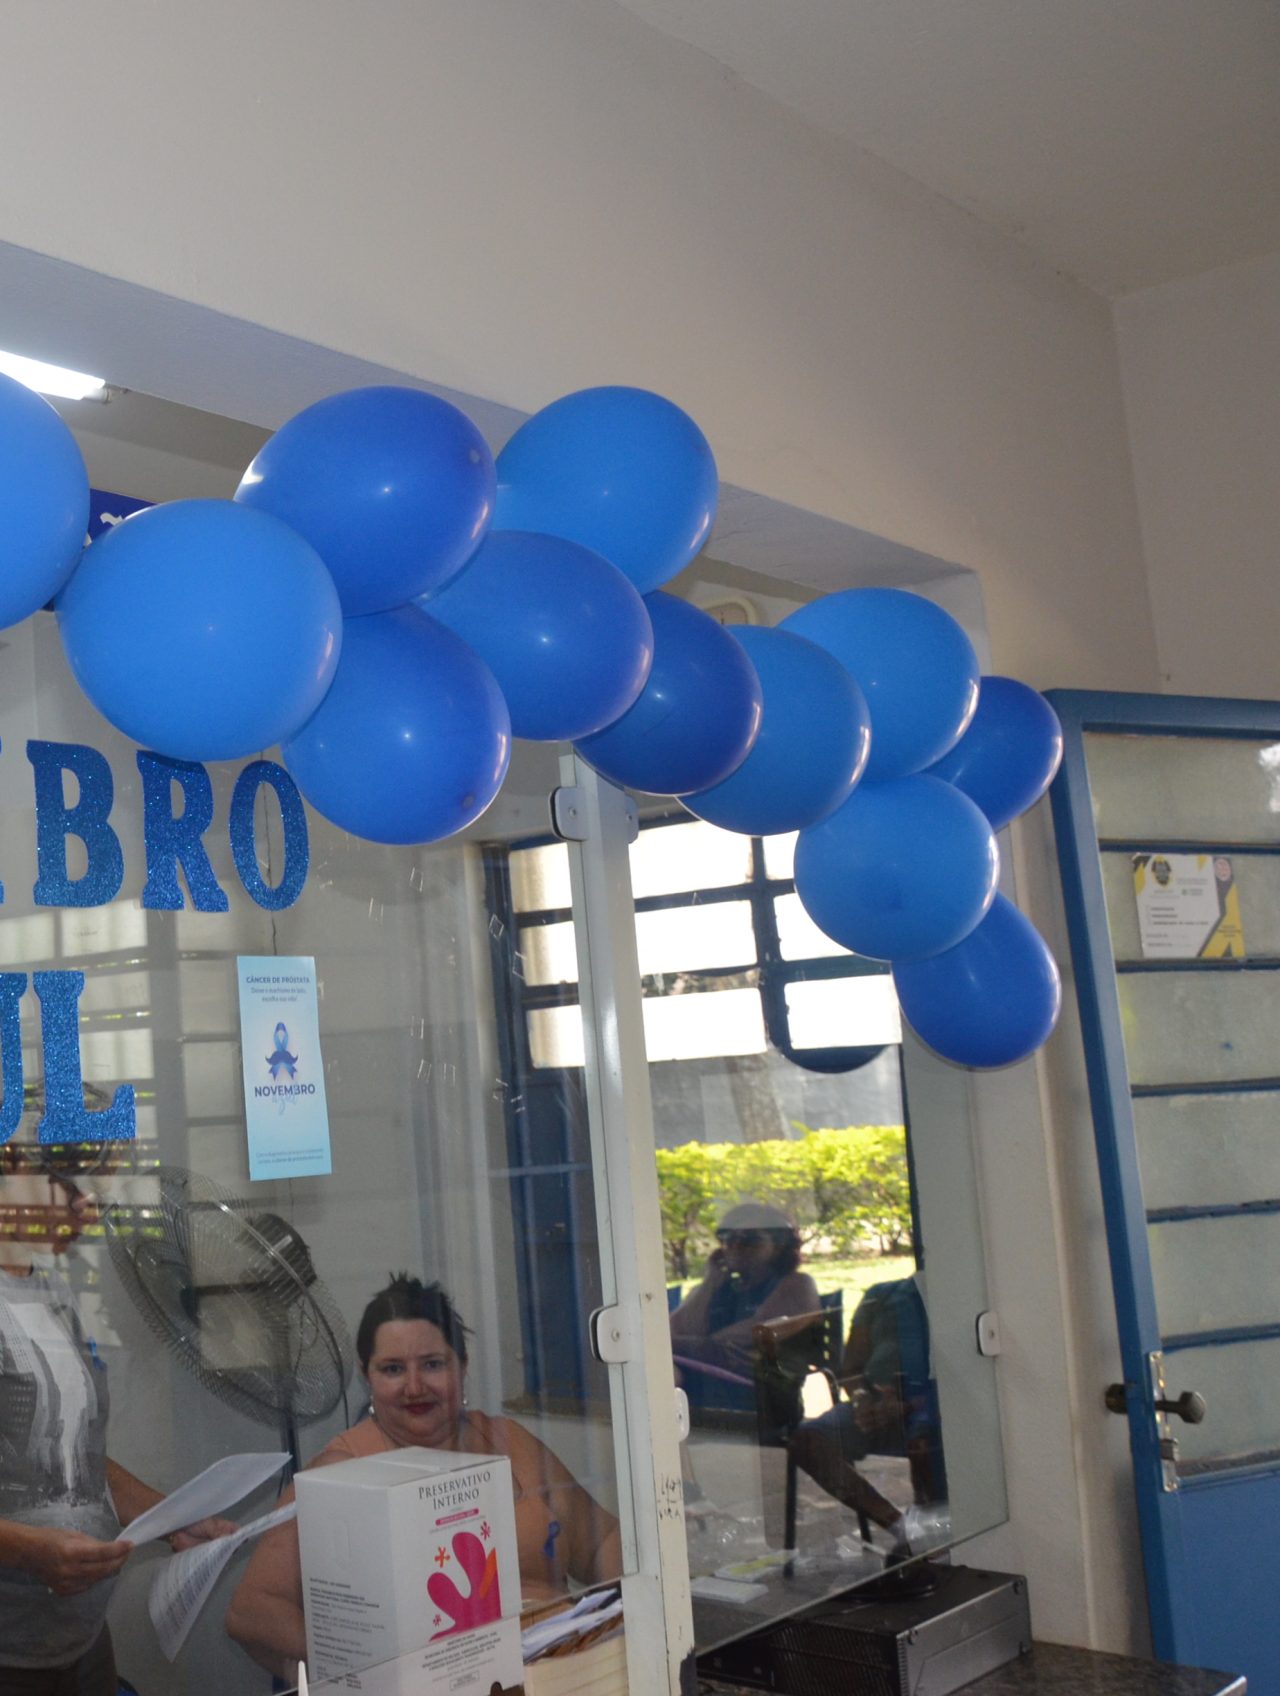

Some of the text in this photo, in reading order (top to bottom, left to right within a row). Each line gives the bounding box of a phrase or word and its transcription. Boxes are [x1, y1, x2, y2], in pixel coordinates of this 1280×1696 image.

[272, 976, 280, 984] DE
[254, 1083, 316, 1097] NOVEMBRO
[418, 1470, 491, 1500] PRESERVATIVO
[433, 1487, 480, 1511] INTERNO
